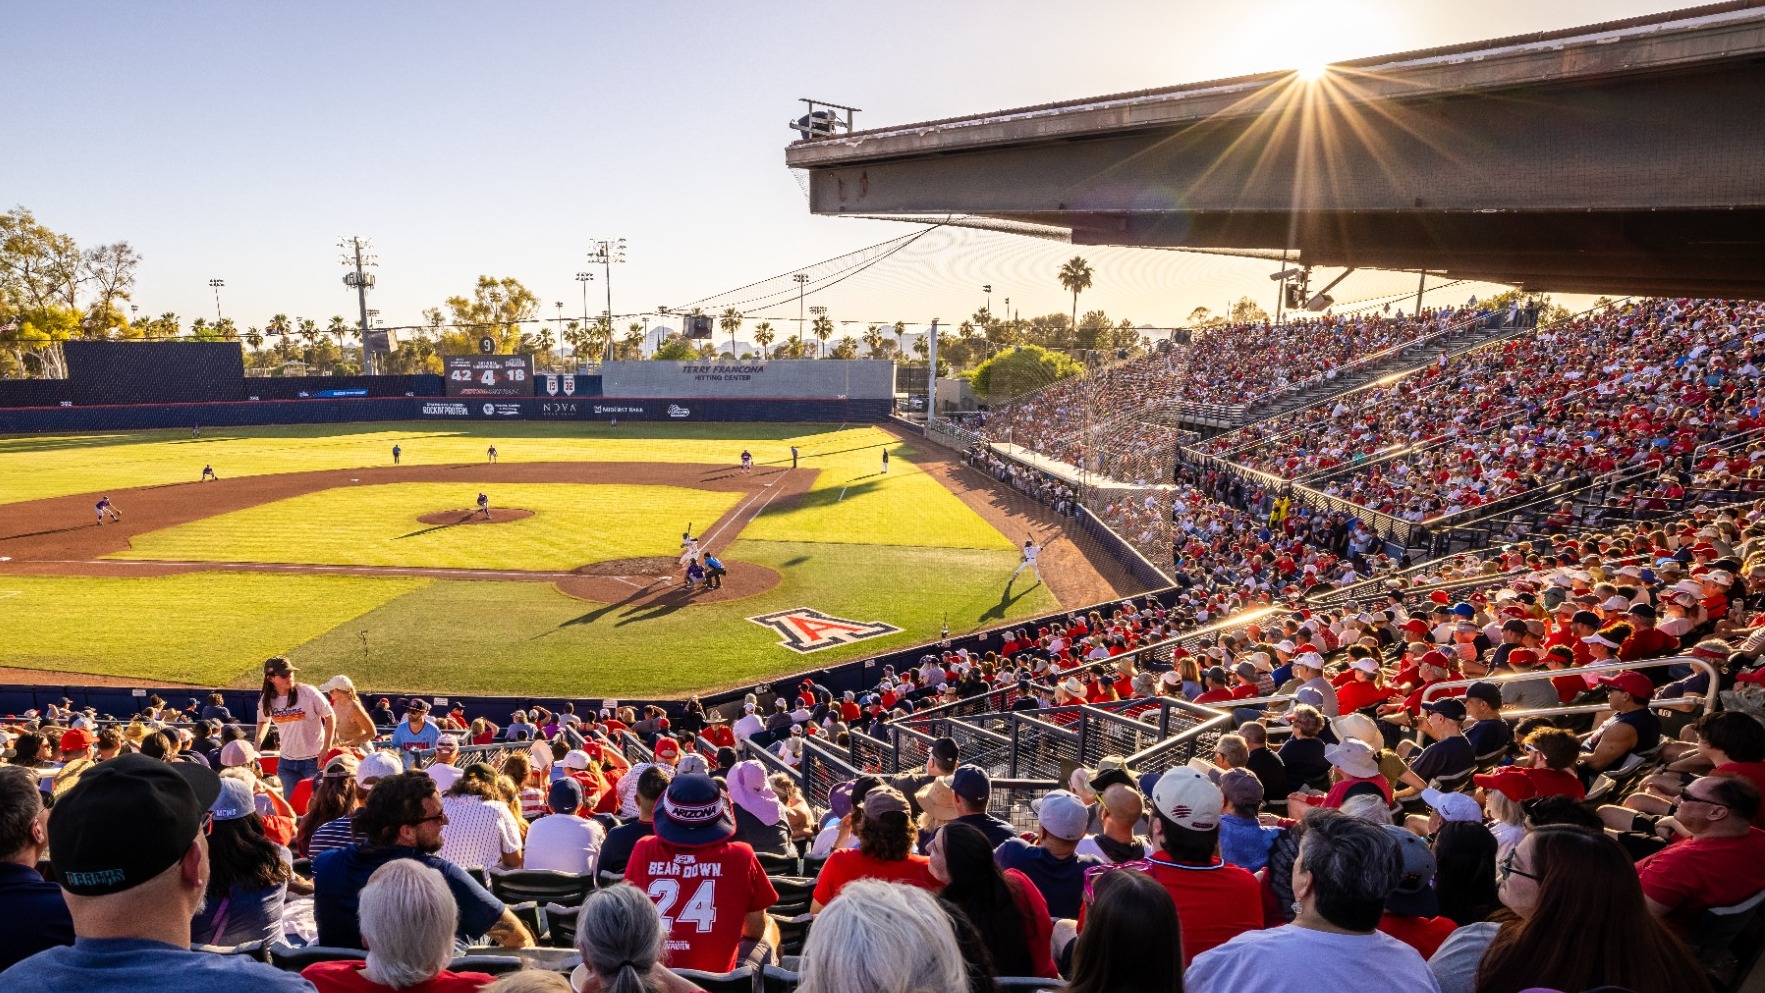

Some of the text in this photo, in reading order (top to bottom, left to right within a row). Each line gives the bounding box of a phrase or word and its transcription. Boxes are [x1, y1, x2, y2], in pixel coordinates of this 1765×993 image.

[483, 339, 491, 352] 9
[451, 369, 472, 381] 42
[506, 369, 525, 381] 18
[682, 366, 764, 374] TERRY FRANCONA
[480, 369, 496, 386] 4
[565, 381, 573, 391] 32
[744, 607, 907, 655] A
[671, 805, 717, 819] ARIZONA
[647, 861, 681, 876] BEAR
[648, 879, 717, 933] 24
